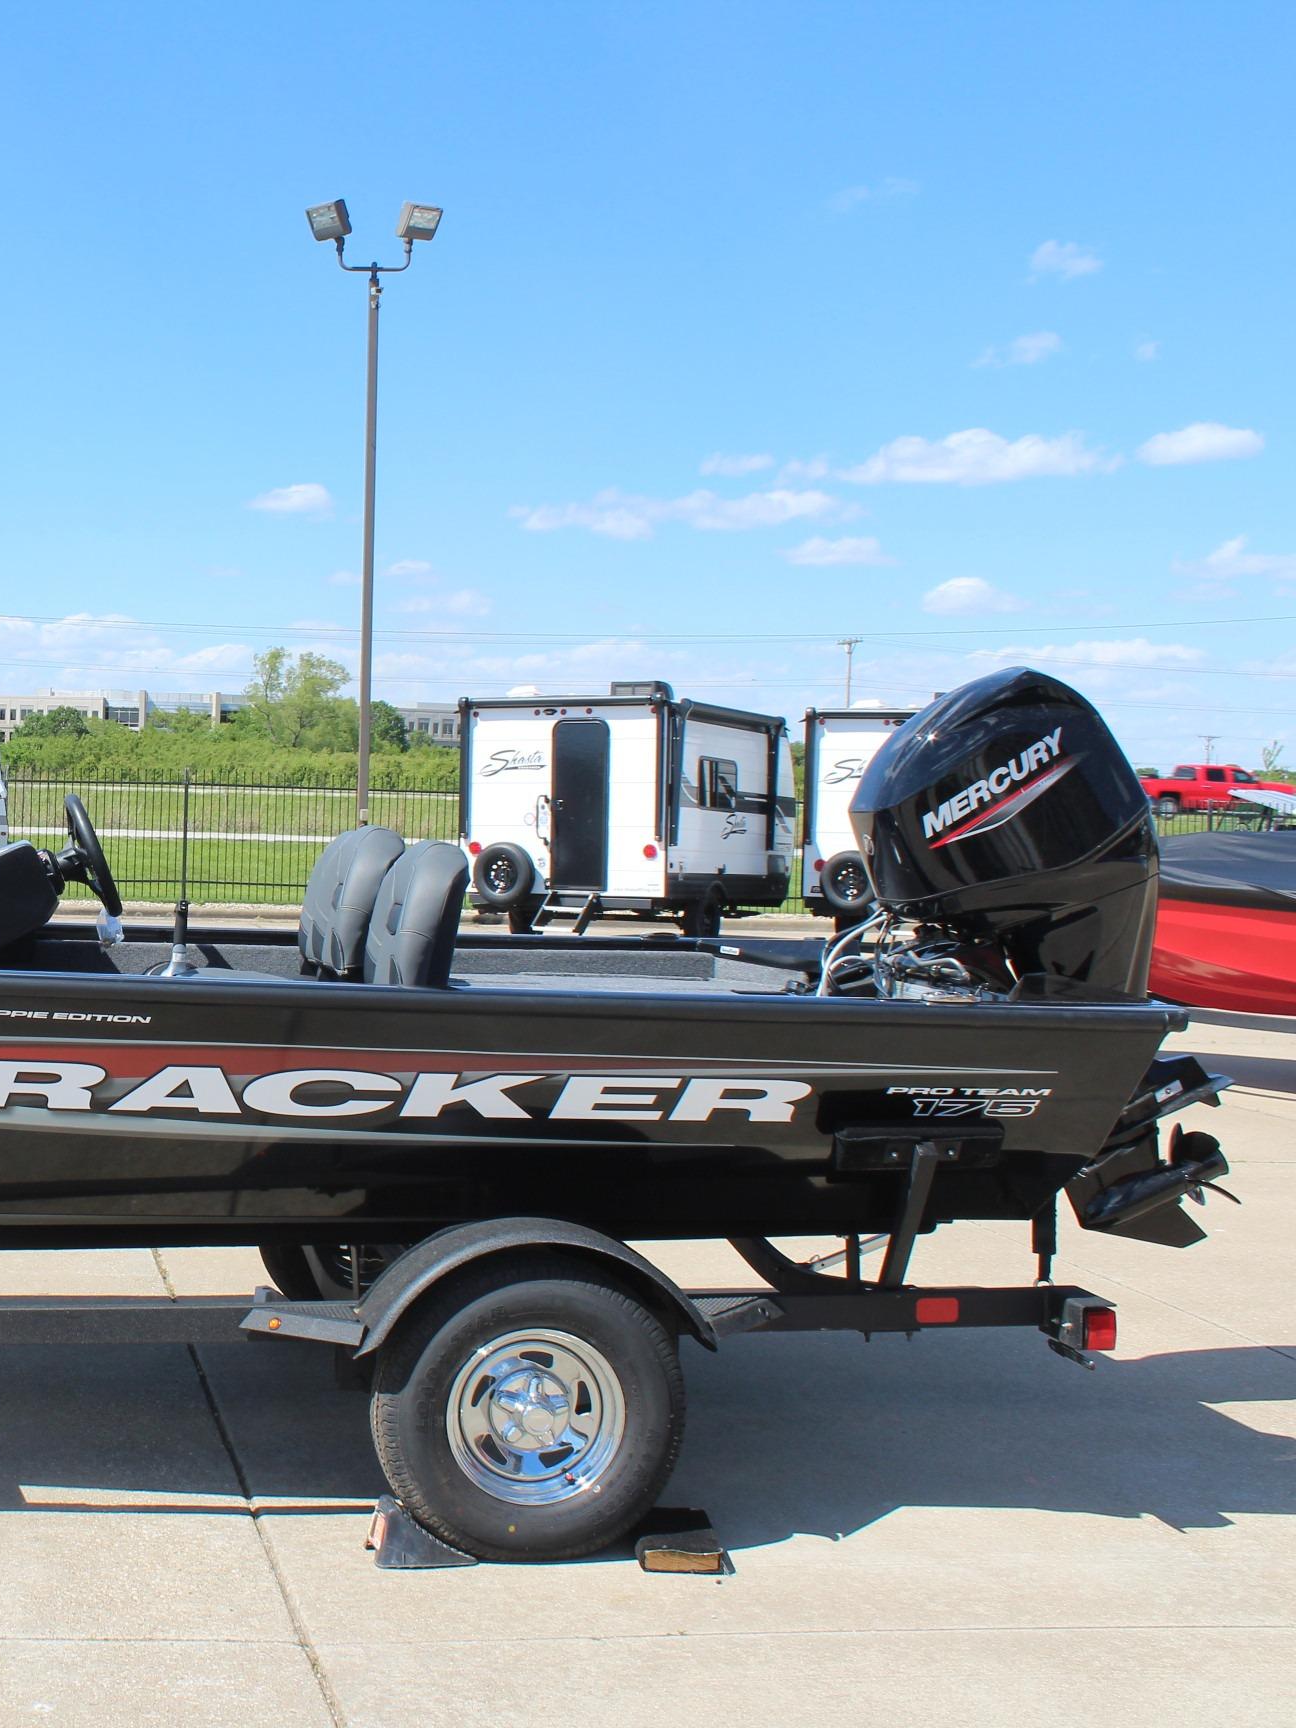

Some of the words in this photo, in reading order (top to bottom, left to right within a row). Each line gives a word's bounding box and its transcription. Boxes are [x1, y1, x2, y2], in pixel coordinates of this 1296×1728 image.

[479, 749, 547, 777] Shasta
[922, 726, 1063, 839] MERCURY
[52, 1012, 152, 1024] EDITION
[886, 1086, 954, 1095] PRO
[959, 1088, 1053, 1096] TEAM
[912, 1098, 1041, 1117] 175
